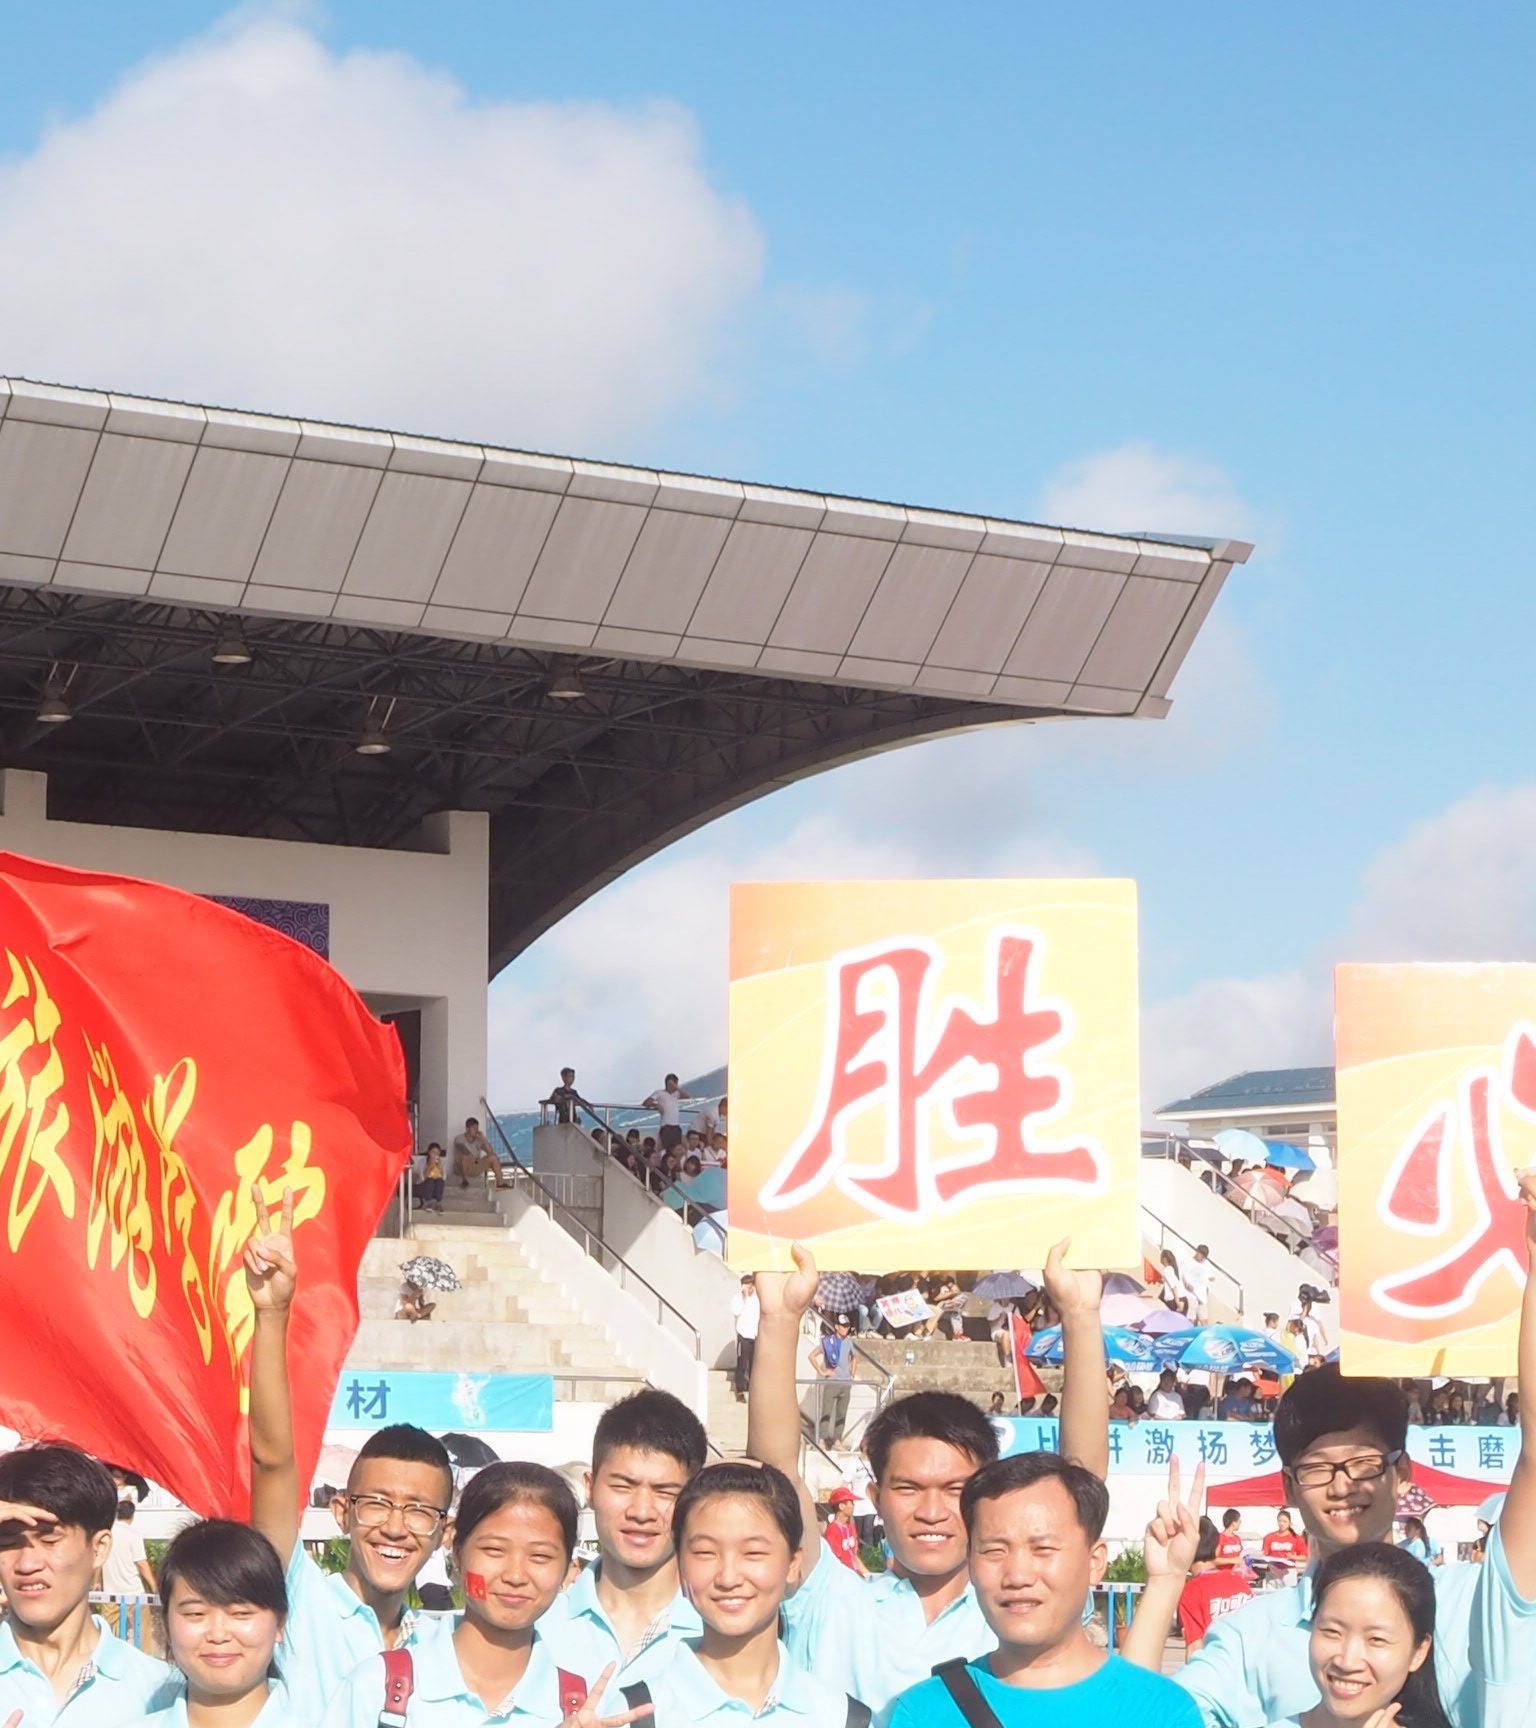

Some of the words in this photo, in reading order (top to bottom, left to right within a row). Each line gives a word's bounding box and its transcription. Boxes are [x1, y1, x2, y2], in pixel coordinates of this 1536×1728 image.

[763, 928, 1105, 1219] 胜
[346, 1379, 391, 1420] 材
[1428, 1433, 1504, 1470] 击磨
